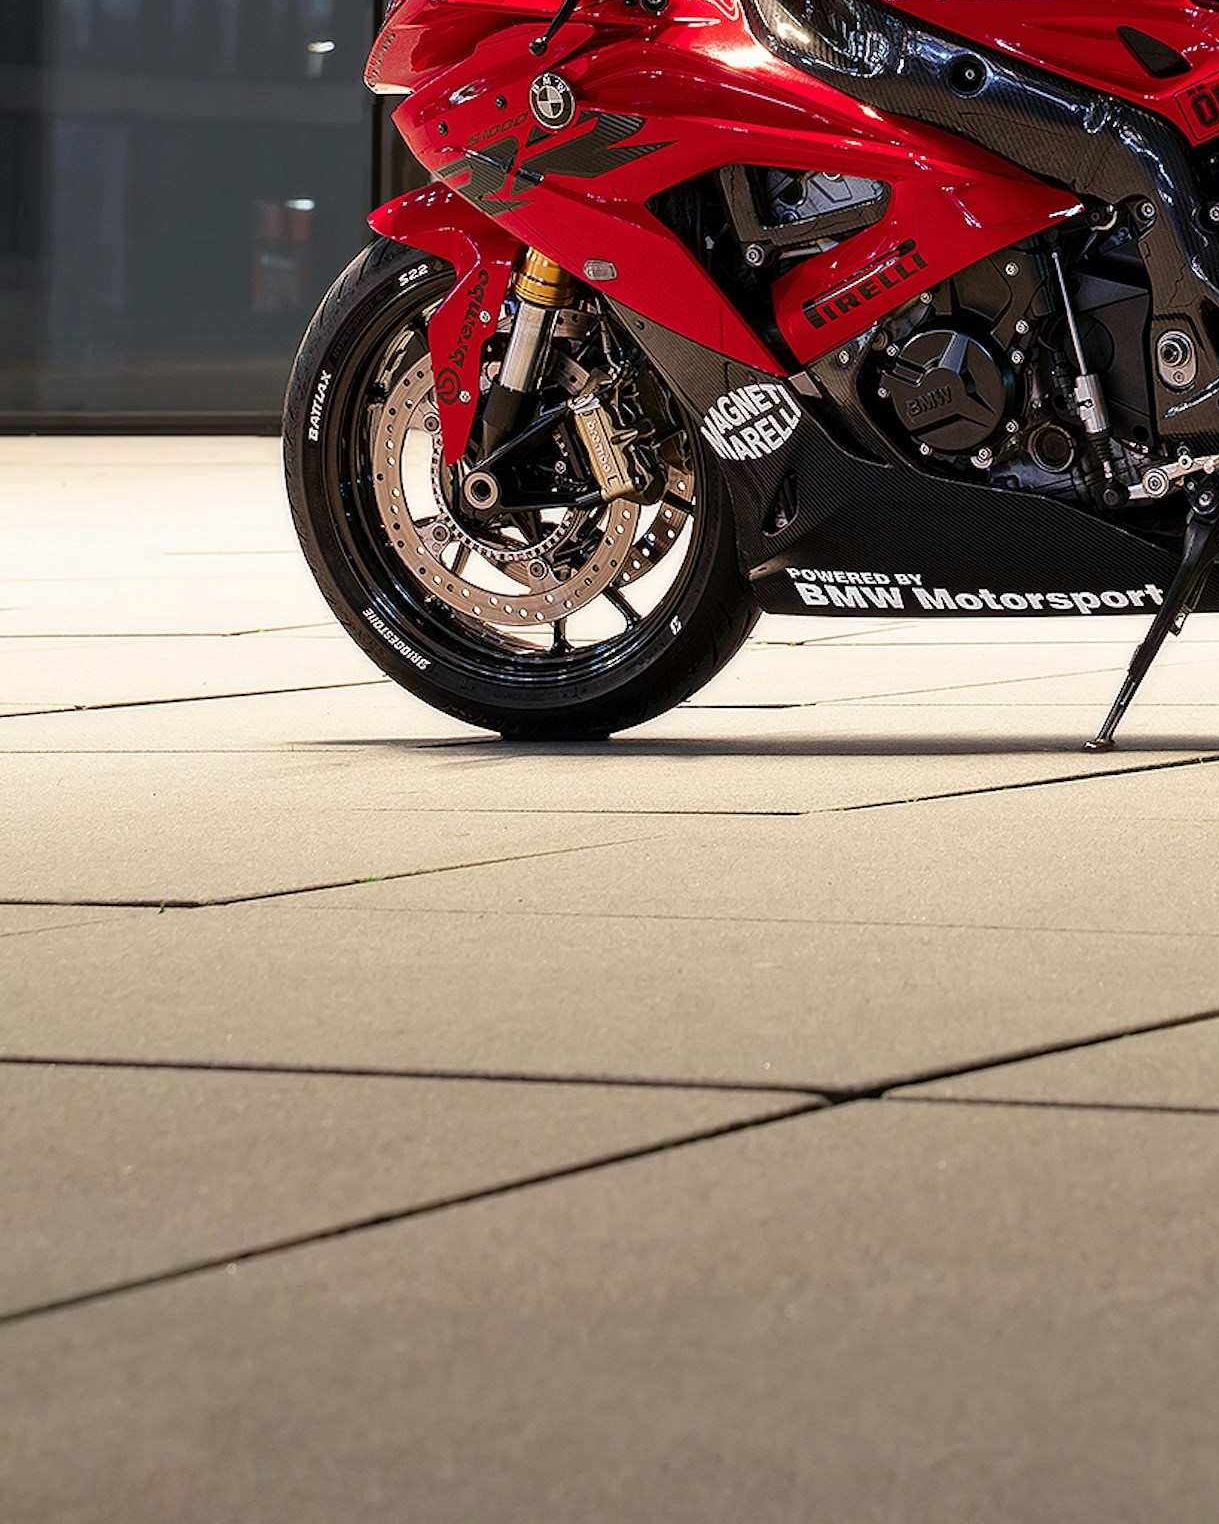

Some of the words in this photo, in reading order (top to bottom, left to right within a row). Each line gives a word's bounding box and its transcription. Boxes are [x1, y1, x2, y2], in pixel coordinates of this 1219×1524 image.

[466, 112, 528, 148] S1000
[397, 263, 430, 287] S22
[802, 238, 928, 330] PIRELLI
[447, 269, 490, 367] brembo
[307, 369, 332, 442] BATTLAX
[701, 384, 801, 460] MAGNETI
[905, 384, 952, 424] BMW
[587, 419, 612, 474] brembo
[701, 406, 801, 461] MARELLI
[785, 567, 891, 585] POWERED
[894, 573, 922, 586] BY
[794, 581, 905, 609] BMW
[911, 583, 1164, 615] Motorsport
[362, 607, 432, 670] BRIDGESTONE
